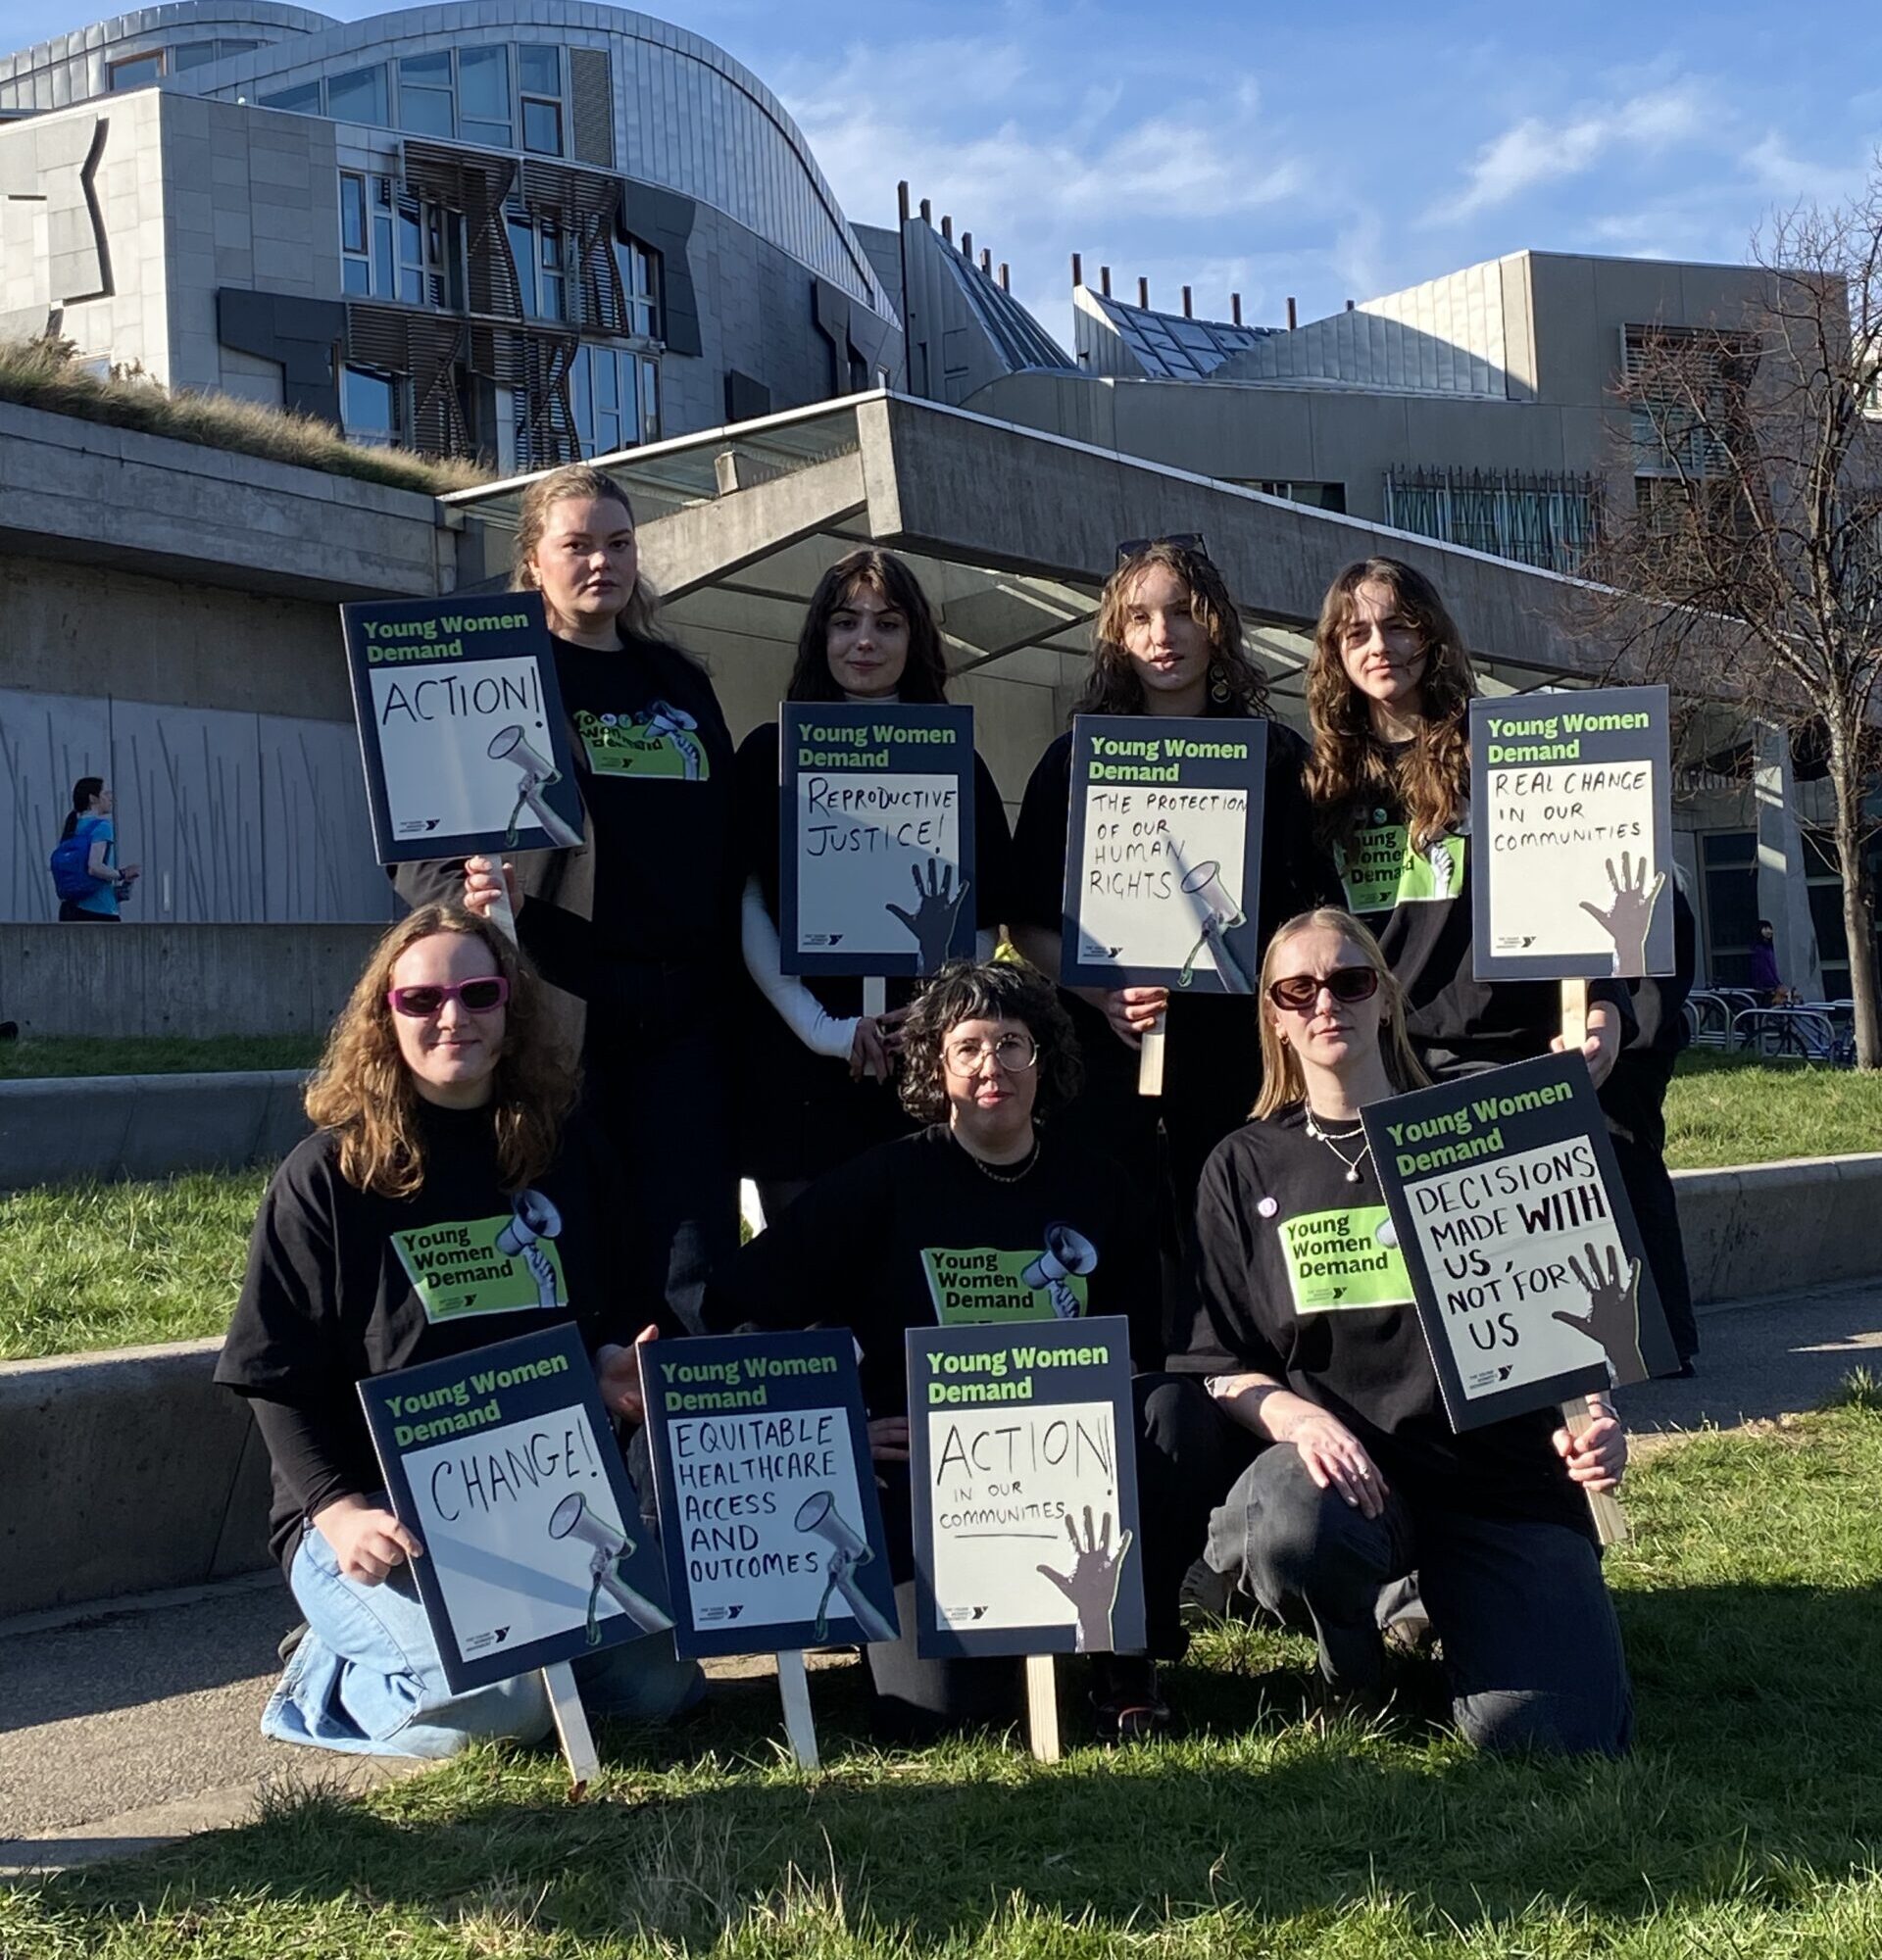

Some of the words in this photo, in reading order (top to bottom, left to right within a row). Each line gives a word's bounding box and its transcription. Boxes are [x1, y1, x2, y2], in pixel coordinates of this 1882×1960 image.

[363, 619, 436, 639] Young
[440, 612, 528, 635] Women
[367, 639, 463, 662] Demand
[382, 666, 544, 728] ACTION!
[798, 723, 868, 747] Young
[872, 724, 957, 744] Women
[1488, 717, 1559, 740] Young
[1562, 711, 1650, 734] Women
[798, 748, 889, 767] Demand
[1091, 737, 1161, 760] Young
[1164, 739, 1248, 760] Women
[1488, 740, 1580, 764] Demand
[1088, 761, 1180, 782] Demand
[1495, 771, 1553, 797] REAL
[1563, 770, 1647, 794] CHANGE
[809, 777, 957, 816] REPRODUCTIVE
[1092, 793, 1131, 814] THE
[1146, 793, 1247, 812] PROTECTION
[1499, 807, 1525, 822] IN
[1543, 803, 1584, 820] OUR
[807, 813, 945, 857] JUSTICE!
[1097, 823, 1120, 839] OF
[1133, 818, 1170, 837] OUR
[1494, 821, 1641, 852] COMMUNITIES
[1095, 840, 1186, 864] HUMAN
[1090, 870, 1172, 900] RIGHTS
[1387, 1106, 1472, 1148] Young
[1471, 1081, 1573, 1123] Women
[1397, 1128, 1505, 1177] Demand
[1415, 1145, 1596, 1216] DECISIONS
[1288, 1215, 1350, 1241] Young
[1429, 1207, 1510, 1252] MADE
[1516, 1183, 1608, 1235] WITH
[403, 1227, 470, 1251] Young
[1293, 1237, 1371, 1260] Women
[414, 1245, 494, 1271] Women
[932, 1252, 998, 1272] Young
[1300, 1251, 1388, 1279] Demand
[425, 1259, 514, 1290] Demand
[938, 1272, 1018, 1289] Women
[946, 1292, 1034, 1308] Demand
[1447, 1279, 1502, 1316] NOT
[1513, 1263, 1571, 1301] FOR
[1468, 1312, 1520, 1350] US
[661, 1358, 741, 1384] Young
[744, 1355, 837, 1376] Women
[927, 1349, 1007, 1375] Young
[1011, 1347, 1108, 1368] Women
[386, 1380, 470, 1418] Young
[470, 1352, 570, 1393] Women
[666, 1385, 768, 1411] Demand
[928, 1376, 1032, 1403] Demand
[394, 1398, 501, 1447] Demand
[676, 1415, 833, 1457] EQUITABLE
[430, 1416, 599, 1522] CHANGE!
[680, 1450, 837, 1488] HEALTHCARE
[936, 1414, 1114, 1496] ACTION!
[955, 1487, 972, 1502] IN
[988, 1481, 1023, 1496] OUR
[686, 1492, 776, 1521] ACCESS
[940, 1501, 1065, 1529] COMMUNITIES
[691, 1525, 759, 1552] AND
[690, 1551, 818, 1583] OUTCOMES
